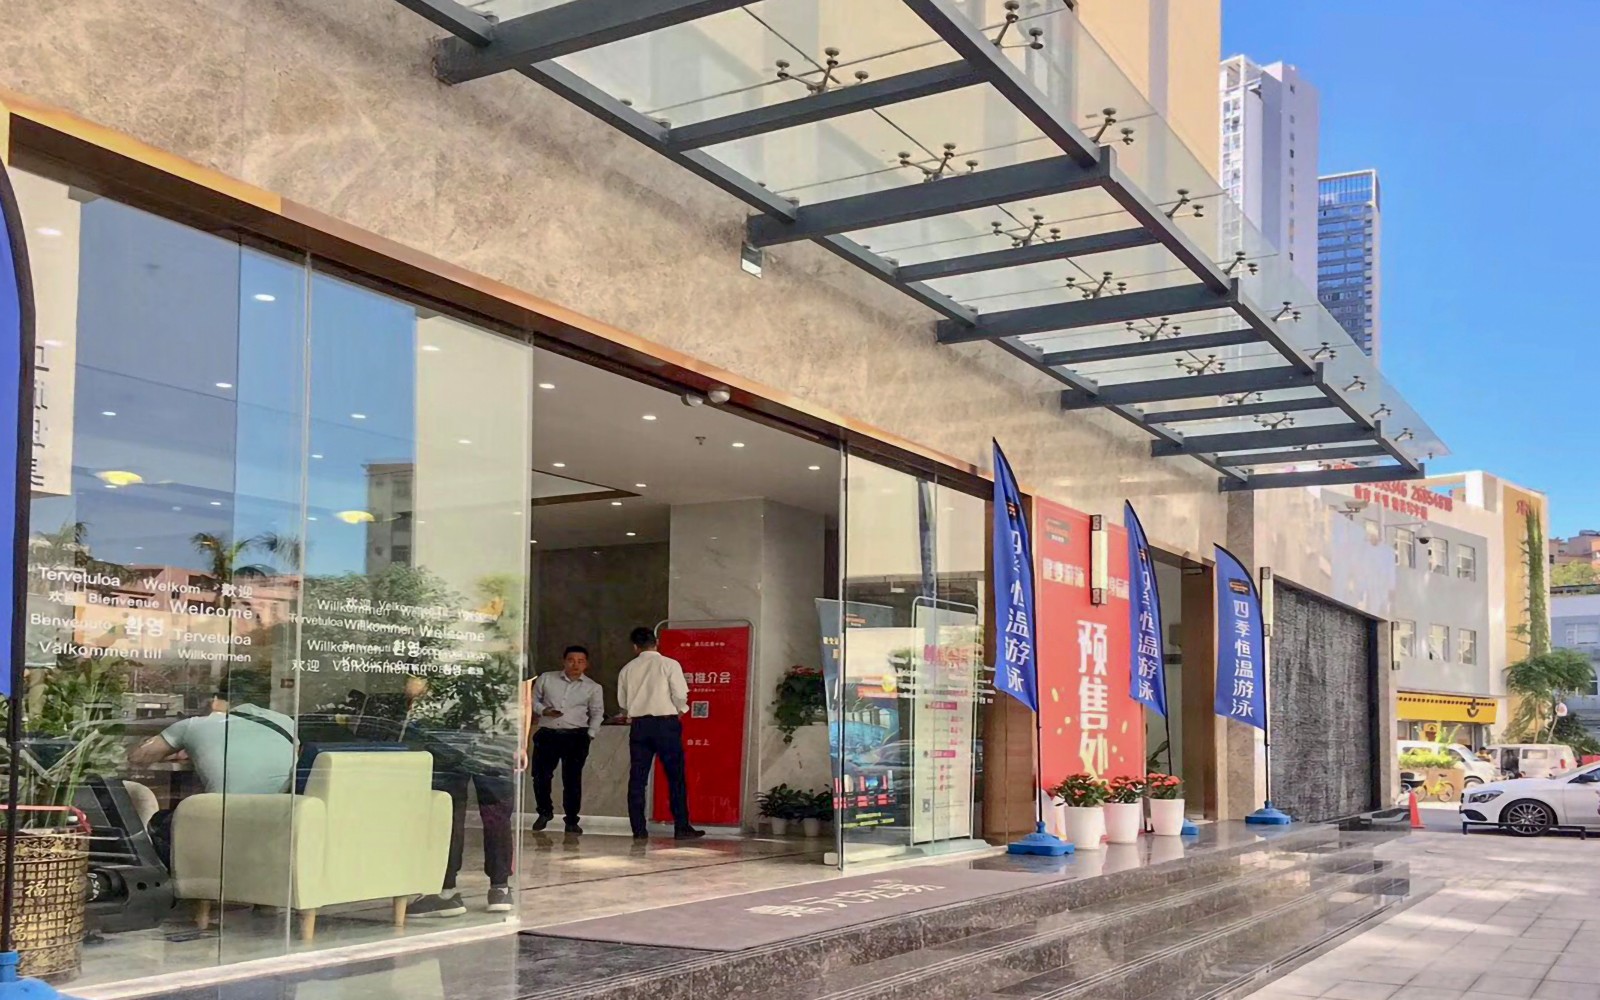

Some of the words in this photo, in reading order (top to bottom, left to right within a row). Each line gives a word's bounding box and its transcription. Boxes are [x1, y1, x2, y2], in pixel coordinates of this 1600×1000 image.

[38, 566, 120, 587] Tervetuloa
[143, 577, 201, 595] Welkom
[88, 592, 160, 609] Bienvenue
[170, 600, 253, 620] Welcome
[174, 628, 252, 646] Tervetuloa
[288, 612, 343, 628] Tervetuloa
[419, 624, 486, 642] Welcome
[1138, 572, 1159, 701] 恒温游泳
[144, 648, 162, 660] till
[178, 648, 252, 663] Willkommen
[1231, 600, 1254, 718] 四季恒温游泳
